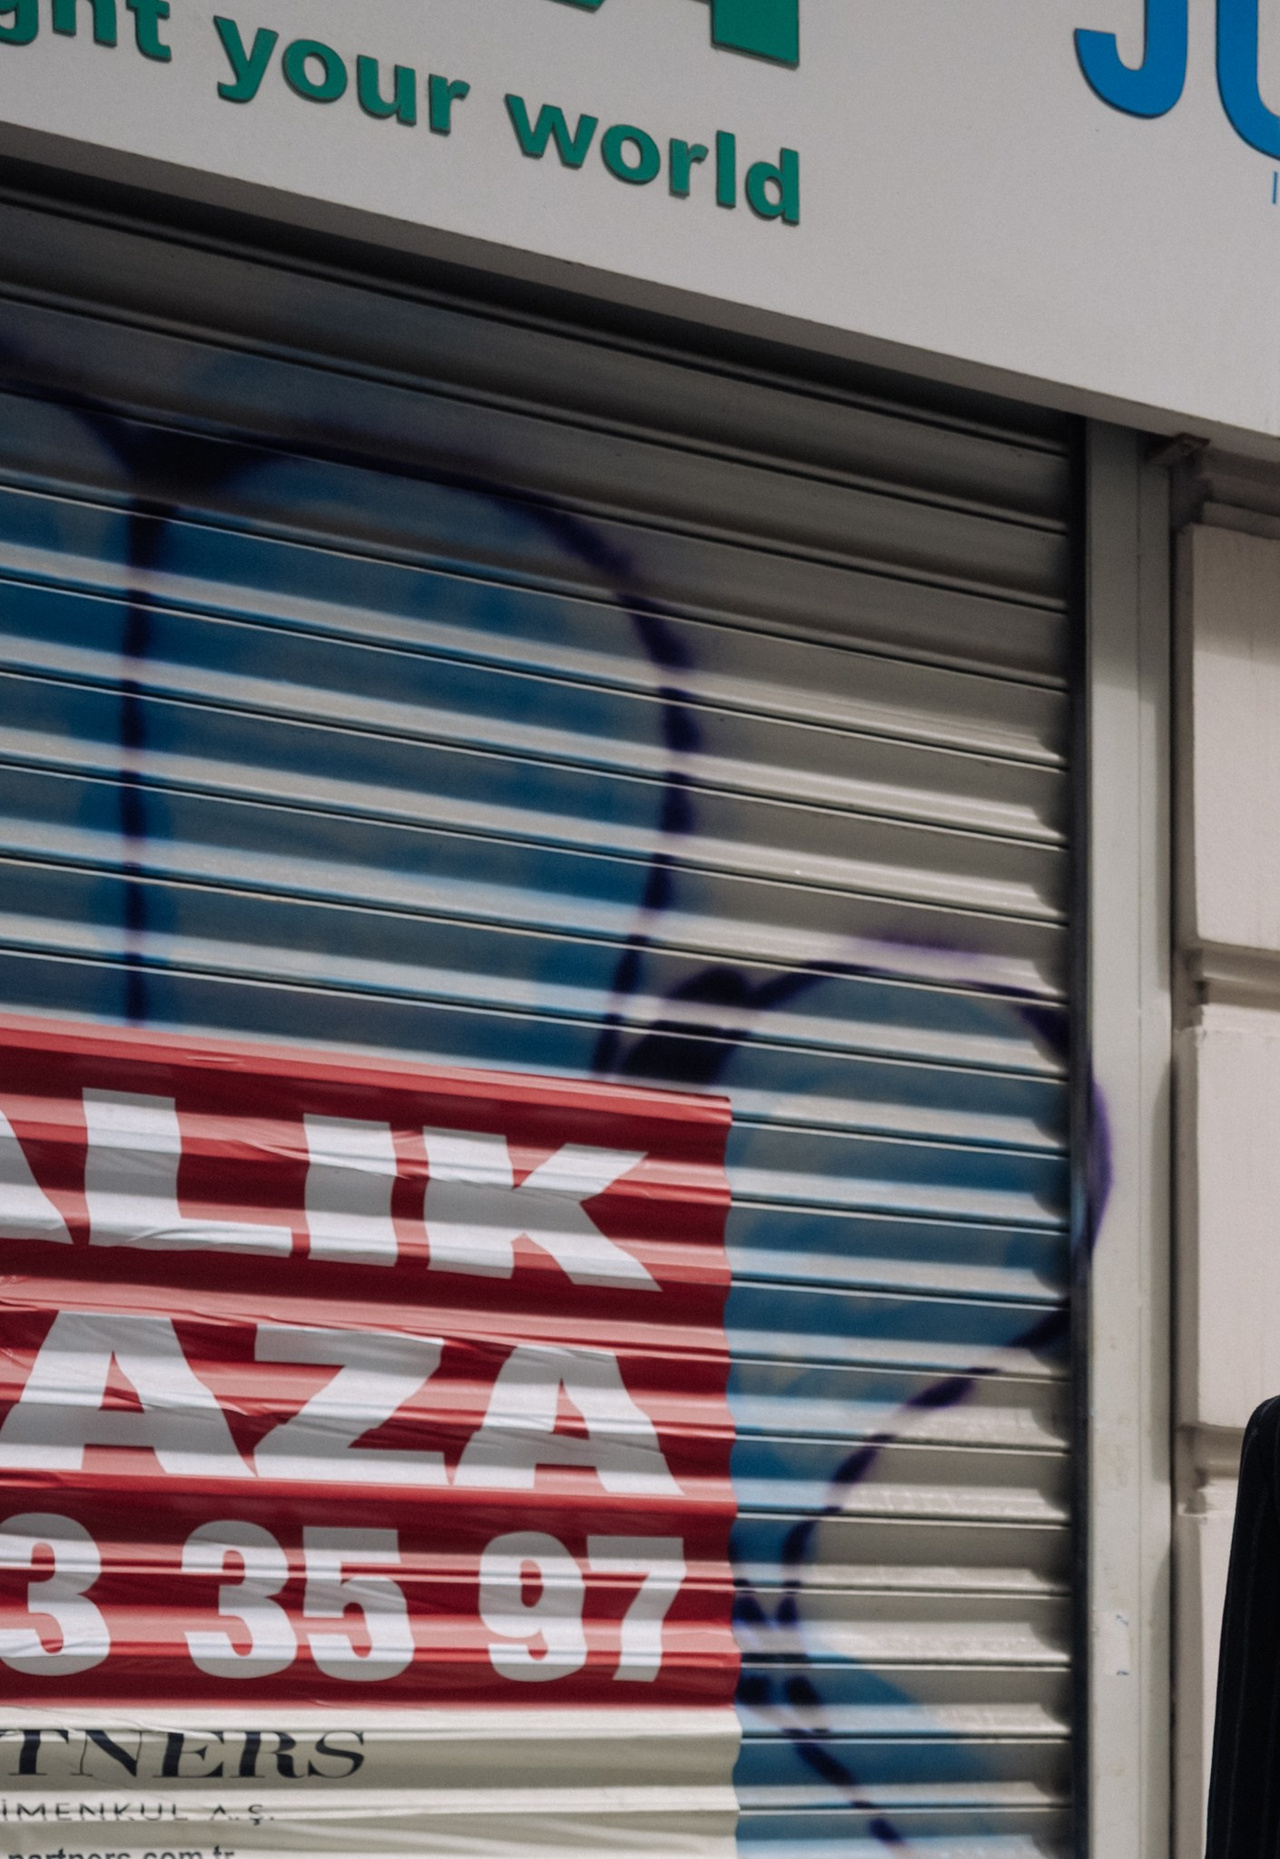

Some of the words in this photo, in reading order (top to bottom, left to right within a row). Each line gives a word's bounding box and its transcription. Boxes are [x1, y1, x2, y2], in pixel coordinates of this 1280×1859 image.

[213, 15, 471, 135] your
[505, 93, 800, 226] world
[0, 1310, 686, 1496] AZA
[0, 1512, 112, 1677] 3
[180, 1519, 415, 1680] 35
[478, 1530, 688, 1683] 97
[0, 1728, 366, 1780] TNERS
